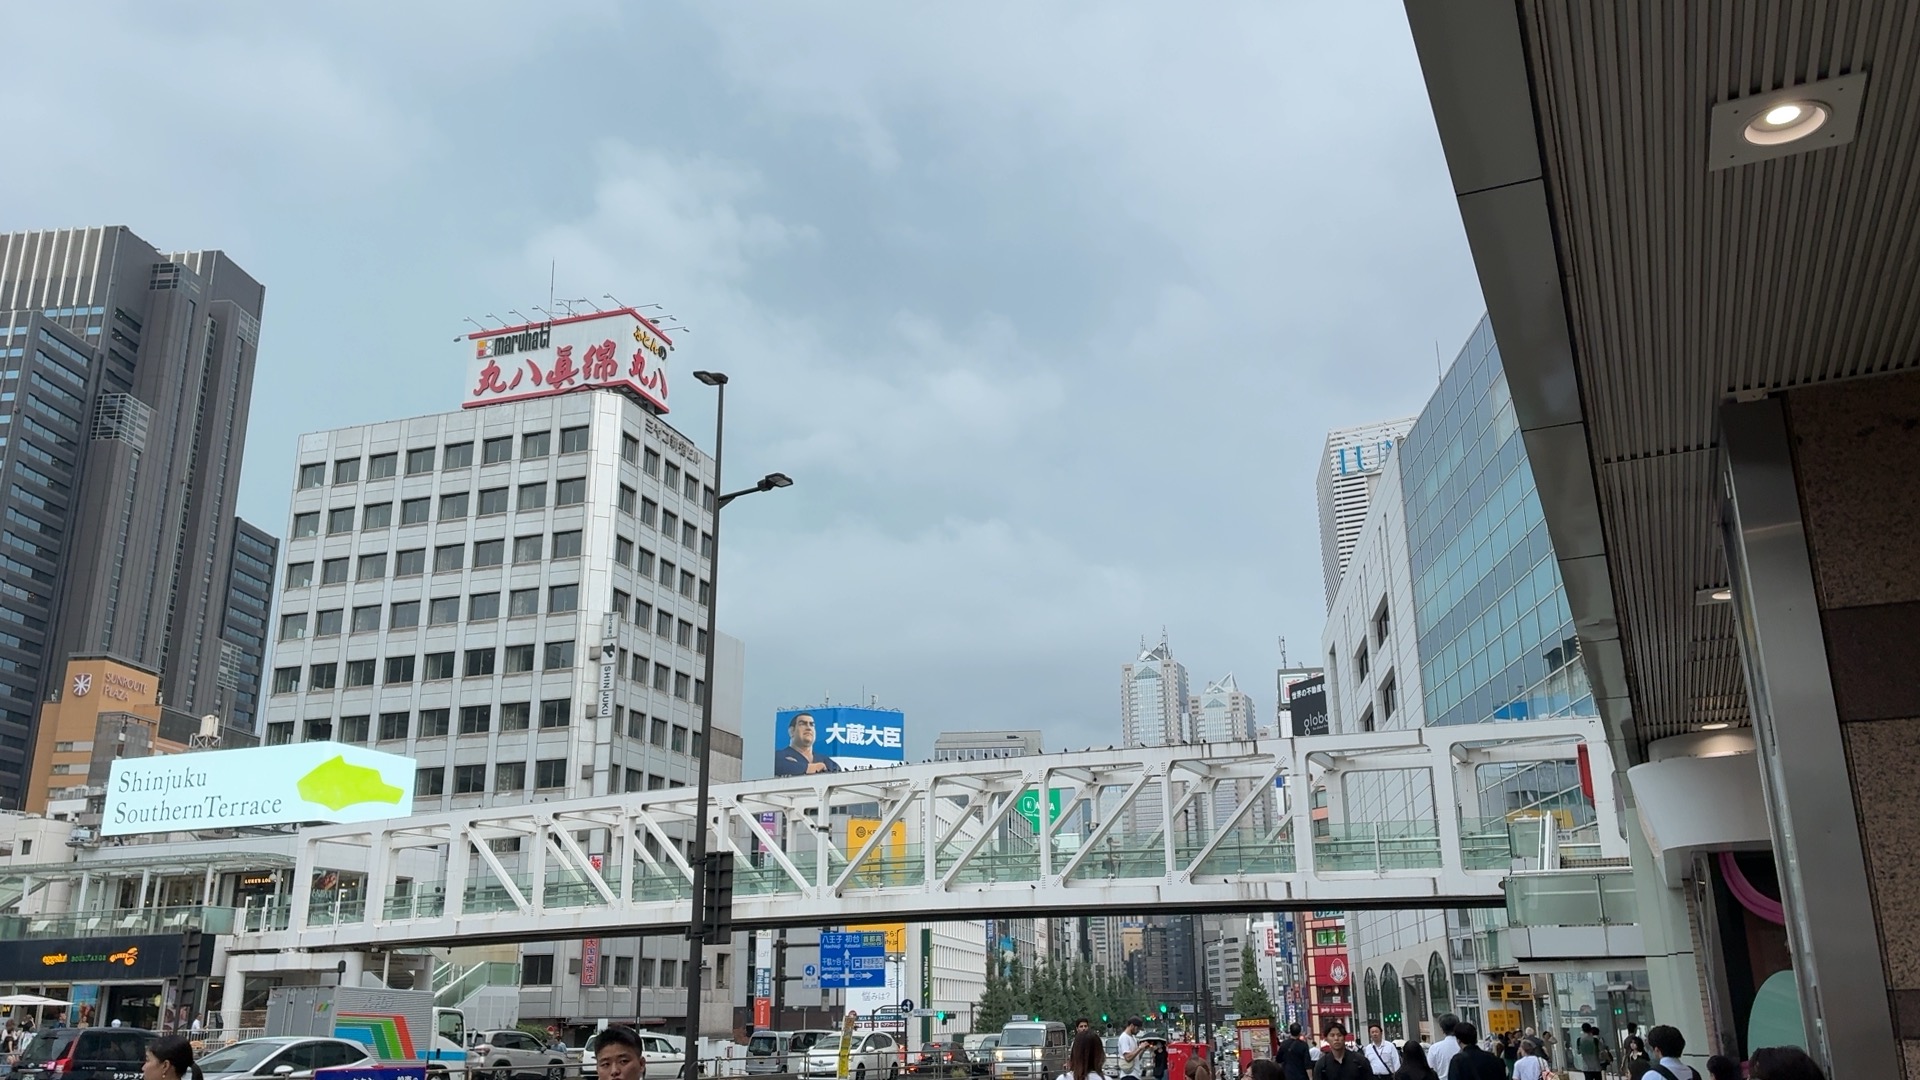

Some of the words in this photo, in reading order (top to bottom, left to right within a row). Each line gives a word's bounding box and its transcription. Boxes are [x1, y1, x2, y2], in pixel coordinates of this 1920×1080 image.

[494, 321, 551, 357] maruhati
[633, 325, 667, 361] ふとんの
[629, 349, 669, 399] 丸八
[103, 684, 129, 702] PLAZA
[105, 672, 148, 696] SUNROUTE
[601, 666, 611, 715] SHINJUKU
[825, 723, 902, 748] 大蔵大臣
[118, 766, 207, 796] Shinjuku
[822, 935, 842, 944] 八王子
[845, 935, 860, 943] 初台
